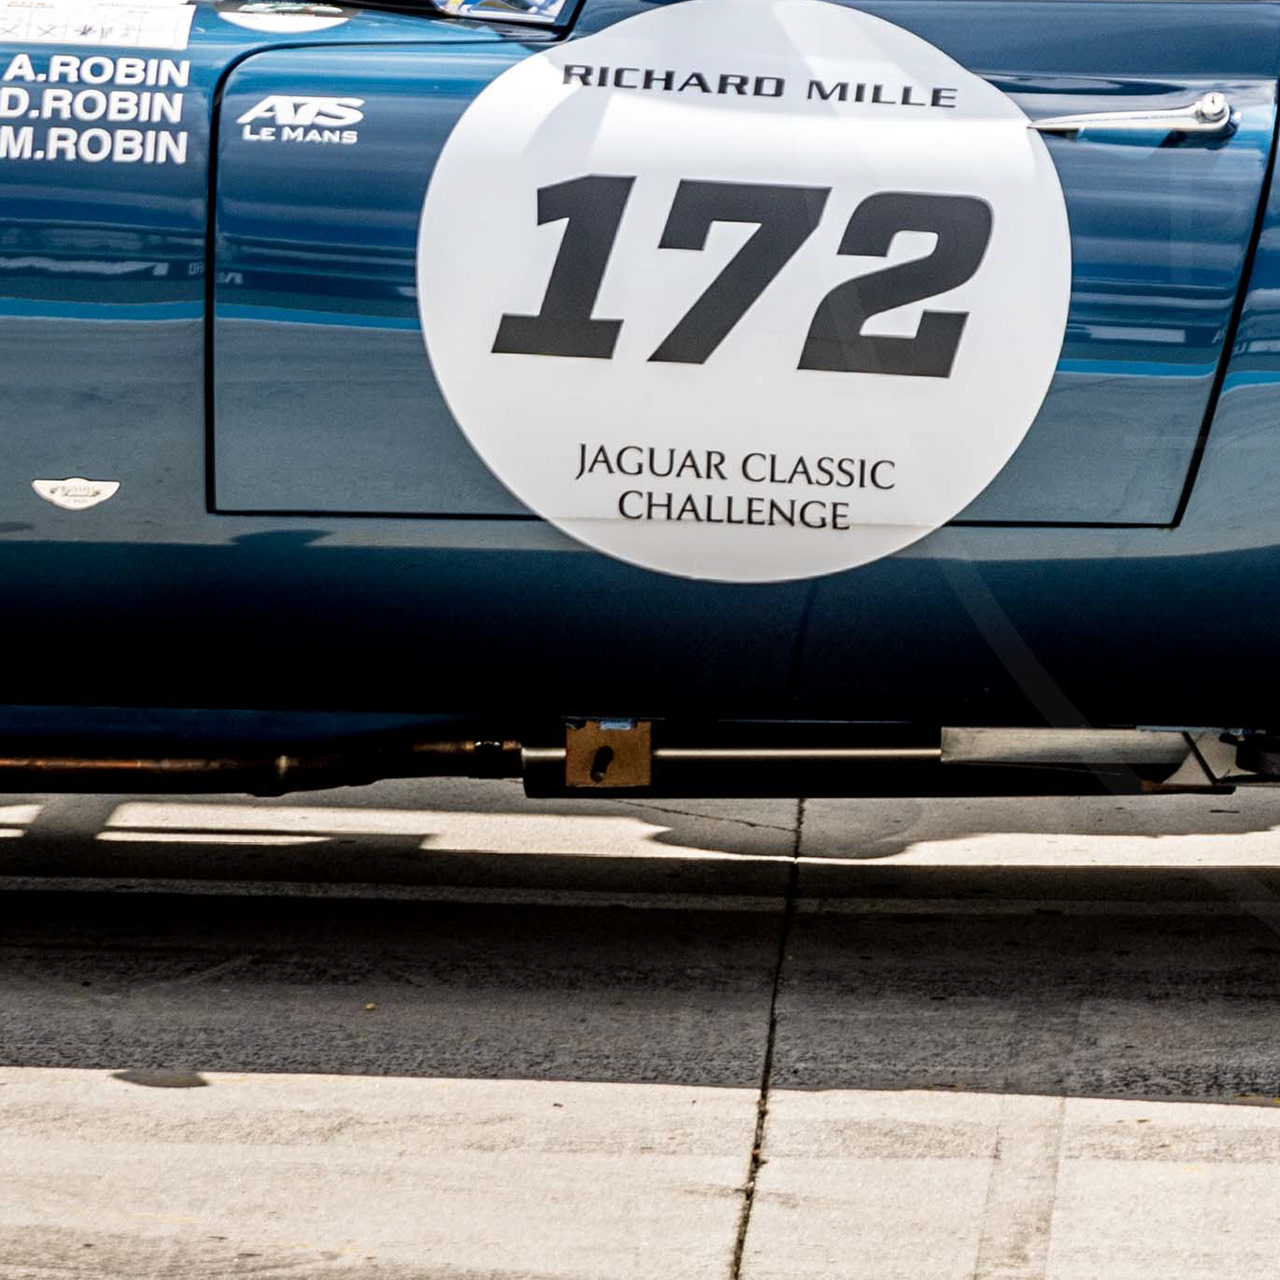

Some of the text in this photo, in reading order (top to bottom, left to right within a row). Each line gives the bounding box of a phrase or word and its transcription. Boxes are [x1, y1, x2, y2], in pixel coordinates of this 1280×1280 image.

[2, 53, 191, 87] A.ROBIN
[563, 63, 958, 109] RICHARD MILLE
[0, 87, 184, 123] D.ROBIN
[236, 95, 366, 127] ATS
[0, 125, 188, 164] M.ROBIN
[242, 124, 358, 144] LE MANS
[490, 173, 995, 379] 172
[575, 443, 897, 490] JAGUAR CLASSIC
[617, 490, 852, 531] CHALLENGE
